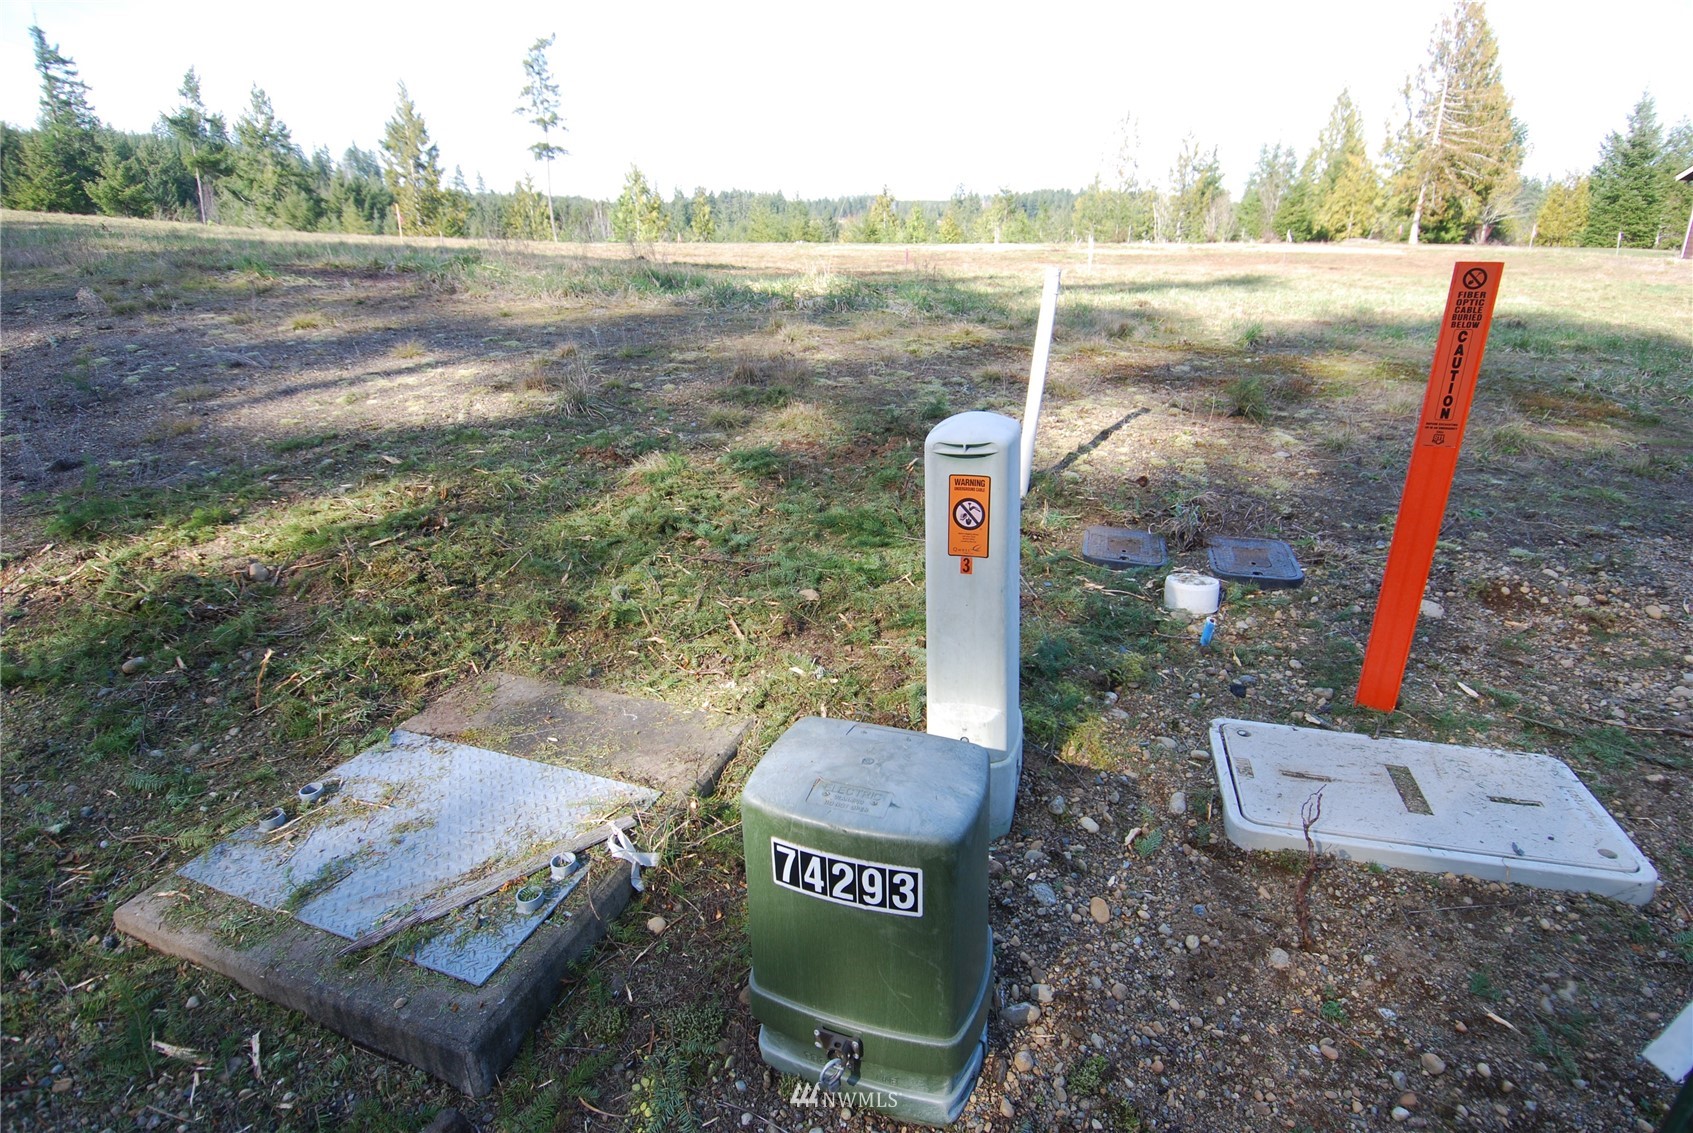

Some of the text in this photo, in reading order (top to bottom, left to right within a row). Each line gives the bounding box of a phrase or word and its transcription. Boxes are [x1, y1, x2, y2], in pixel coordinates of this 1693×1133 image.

[1457, 291, 1486, 299] FIBER
[1440, 330, 1468, 419] CAUTION
[954, 478, 986, 487] WARNING
[962, 558, 970, 572] 3
[823, 783, 883, 801] ELECTRIC
[775, 844, 916, 910] 74293
